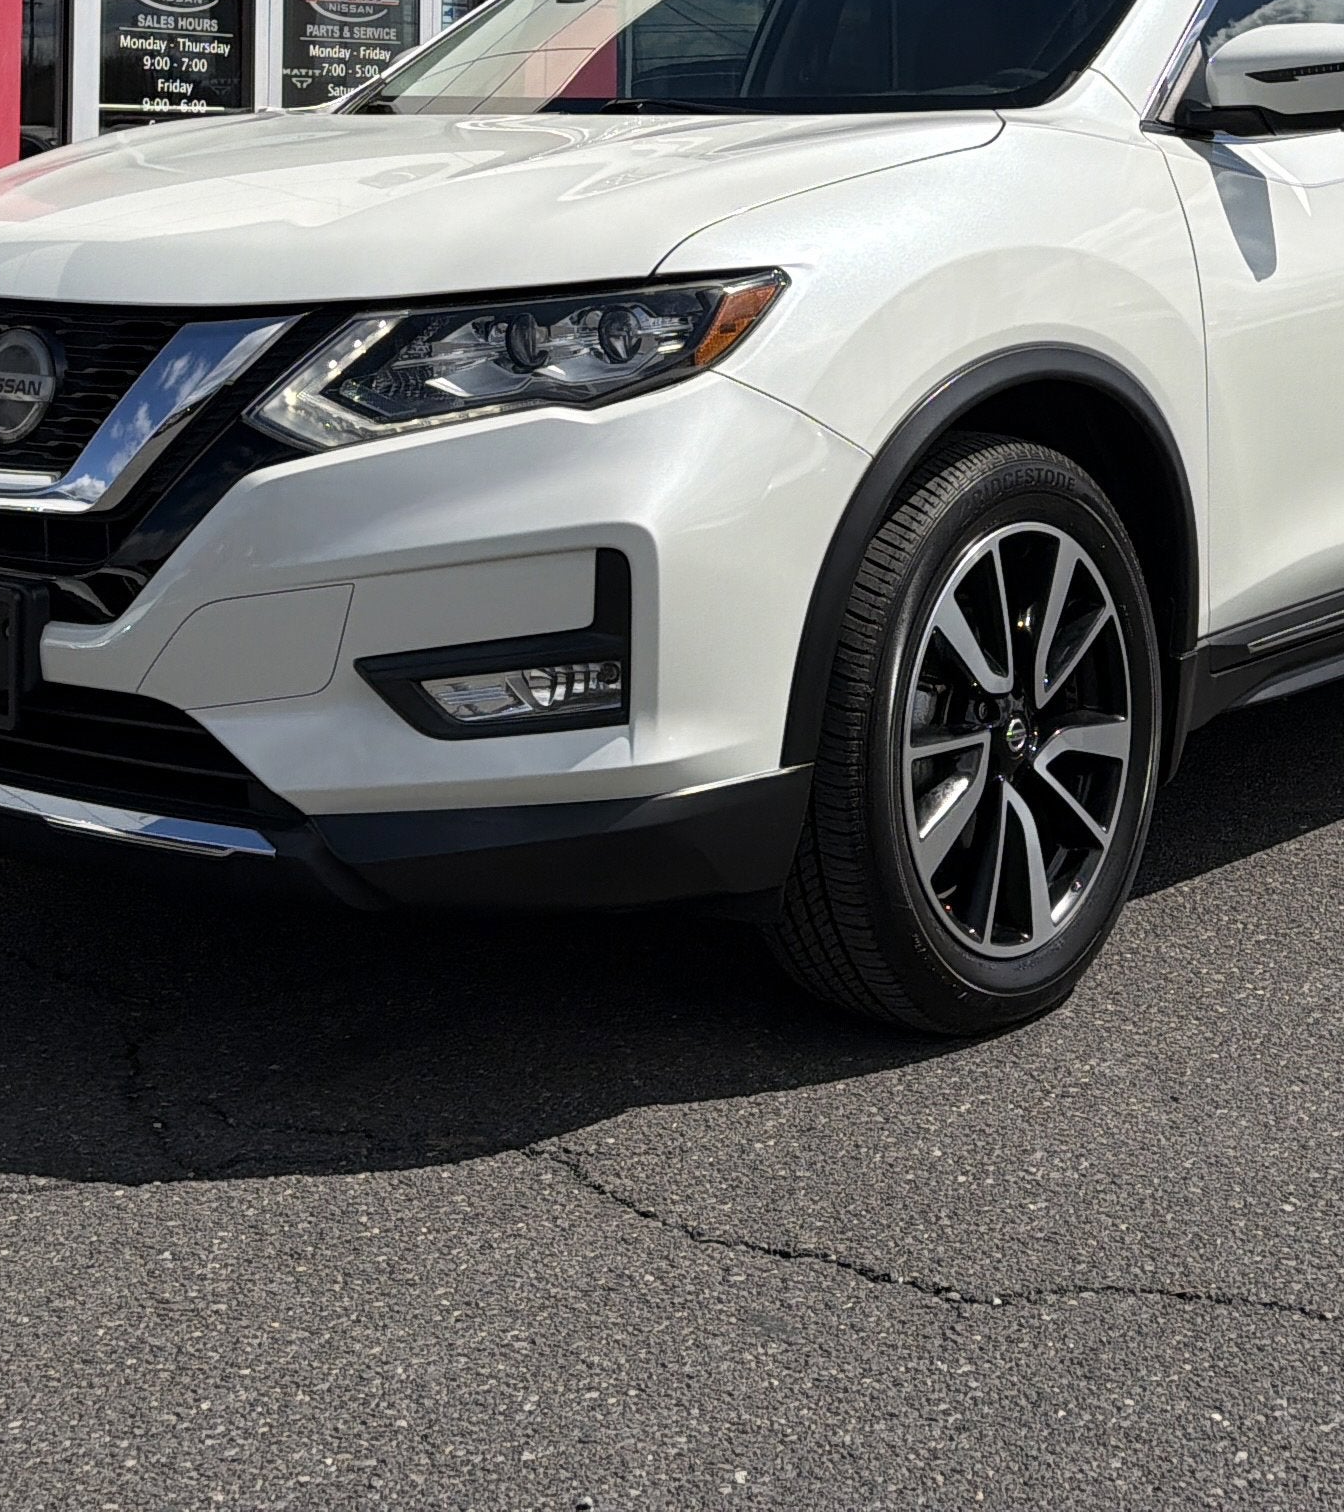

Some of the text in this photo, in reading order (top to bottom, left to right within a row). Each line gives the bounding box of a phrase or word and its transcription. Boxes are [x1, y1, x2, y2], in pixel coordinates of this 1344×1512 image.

[328, 3, 374, 15] NISSAN
[137, 14, 218, 32] SALES HOURS
[306, 24, 397, 40] PARTS & SERVICE
[119, 34, 167, 52] Monday
[177, 38, 231, 57] Thursday
[309, 45, 351, 60] Monday
[359, 47, 392, 63] Friday
[143, 56, 170, 70] 9:00
[181, 58, 207, 72] 7:00
[322, 63, 346, 77] 7:00
[355, 65, 379, 77] 5:00
[157, 78, 194, 96] Friday
[142, 97, 170, 112] 9:00
[180, 99, 207, 113] 6:00
[959, 467, 1076, 514] RIDGESTONE
